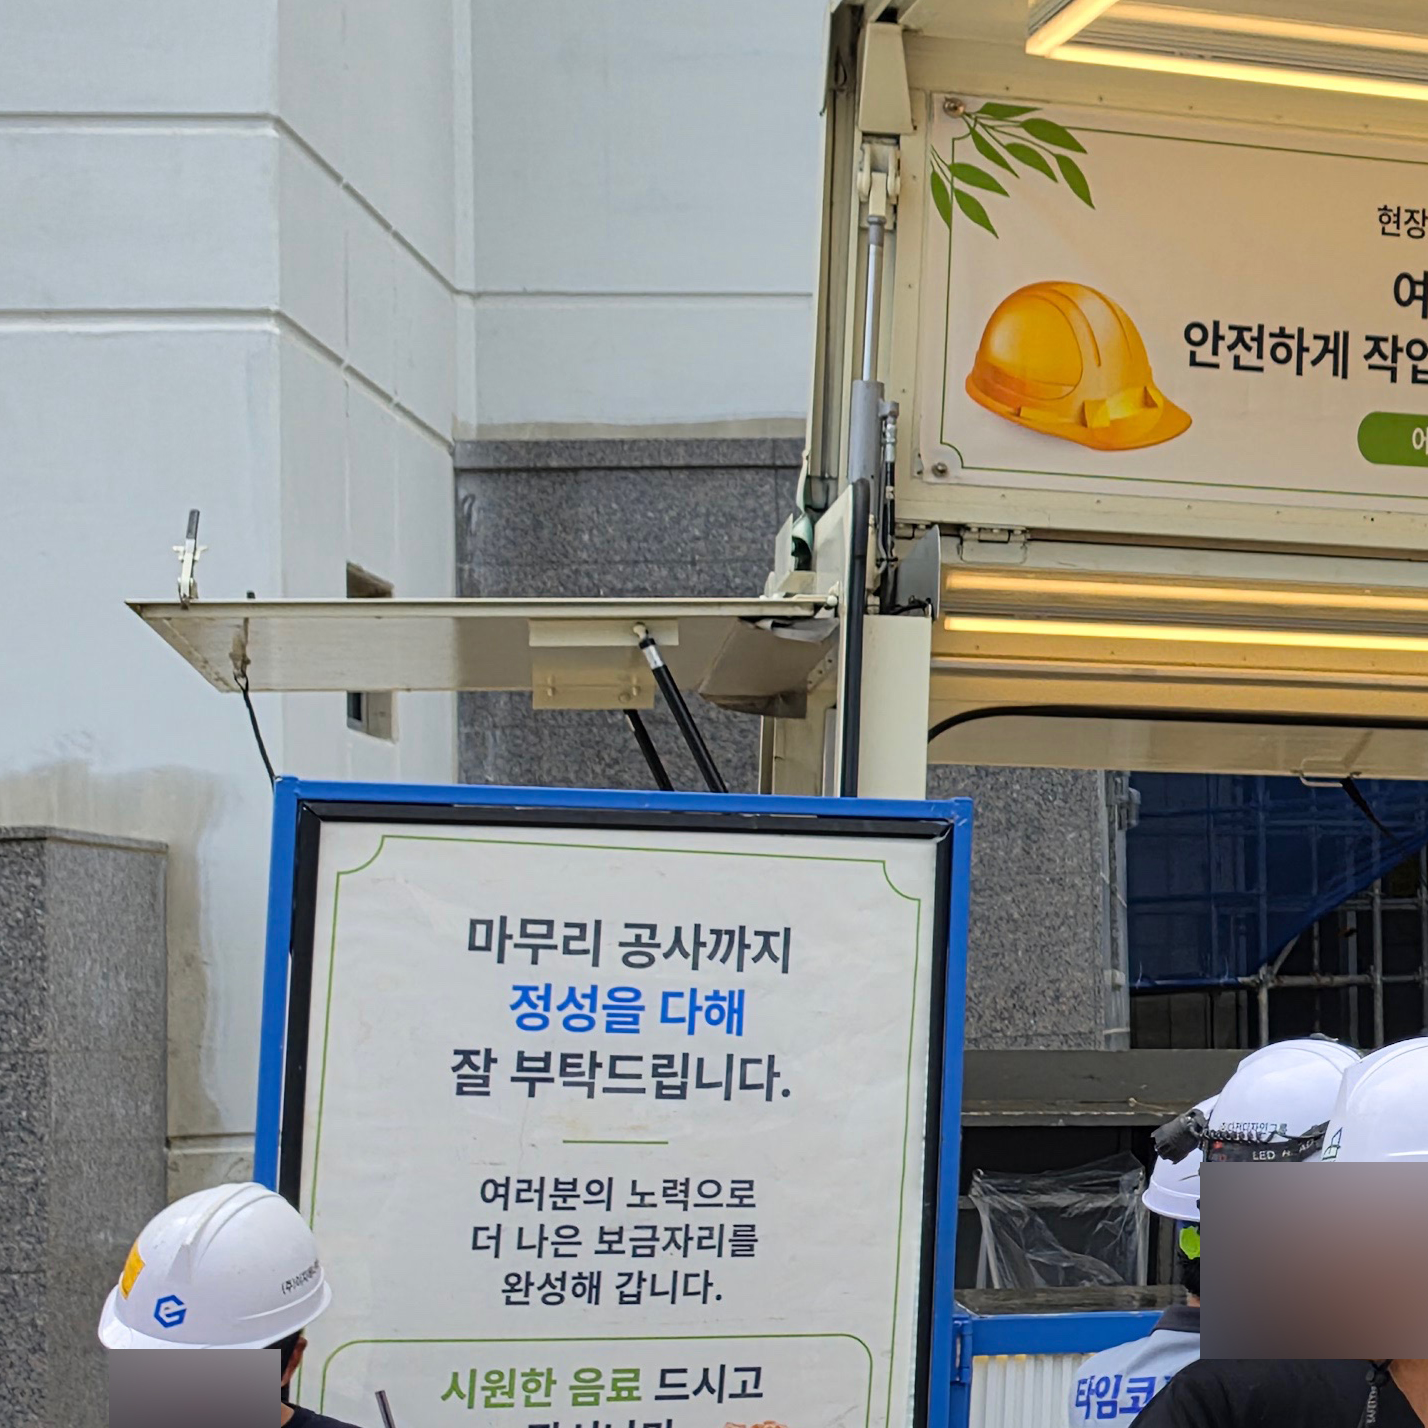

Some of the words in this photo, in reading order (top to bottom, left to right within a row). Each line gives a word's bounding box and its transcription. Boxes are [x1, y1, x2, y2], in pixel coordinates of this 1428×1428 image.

[1184, 320, 1350, 379] 안전하게
[468, 915, 603, 968] 마무리
[618, 922, 792, 975] 공사까지
[509, 984, 645, 1034] 정성을
[660, 988, 746, 1038] 다해
[450, 1048, 497, 1097] 잘
[509, 1050, 791, 1102] 부탁드립니다.
[1252, 1150, 1276, 1161] LED
[479, 1176, 614, 1213] 여러분의
[625, 1178, 756, 1212] 노력으로
[471, 1224, 502, 1259] 더
[515, 1224, 583, 1259] 나은
[594, 1222, 759, 1260] 보금자리를
[501, 1270, 602, 1307] 완성해
[613, 1269, 722, 1306] 갑니다.
[441, 1367, 557, 1410] 시원한
[569, 1367, 642, 1405] 음료
[654, 1365, 764, 1403] 드시고
[1076, 1374, 1171, 1420] 타임코
